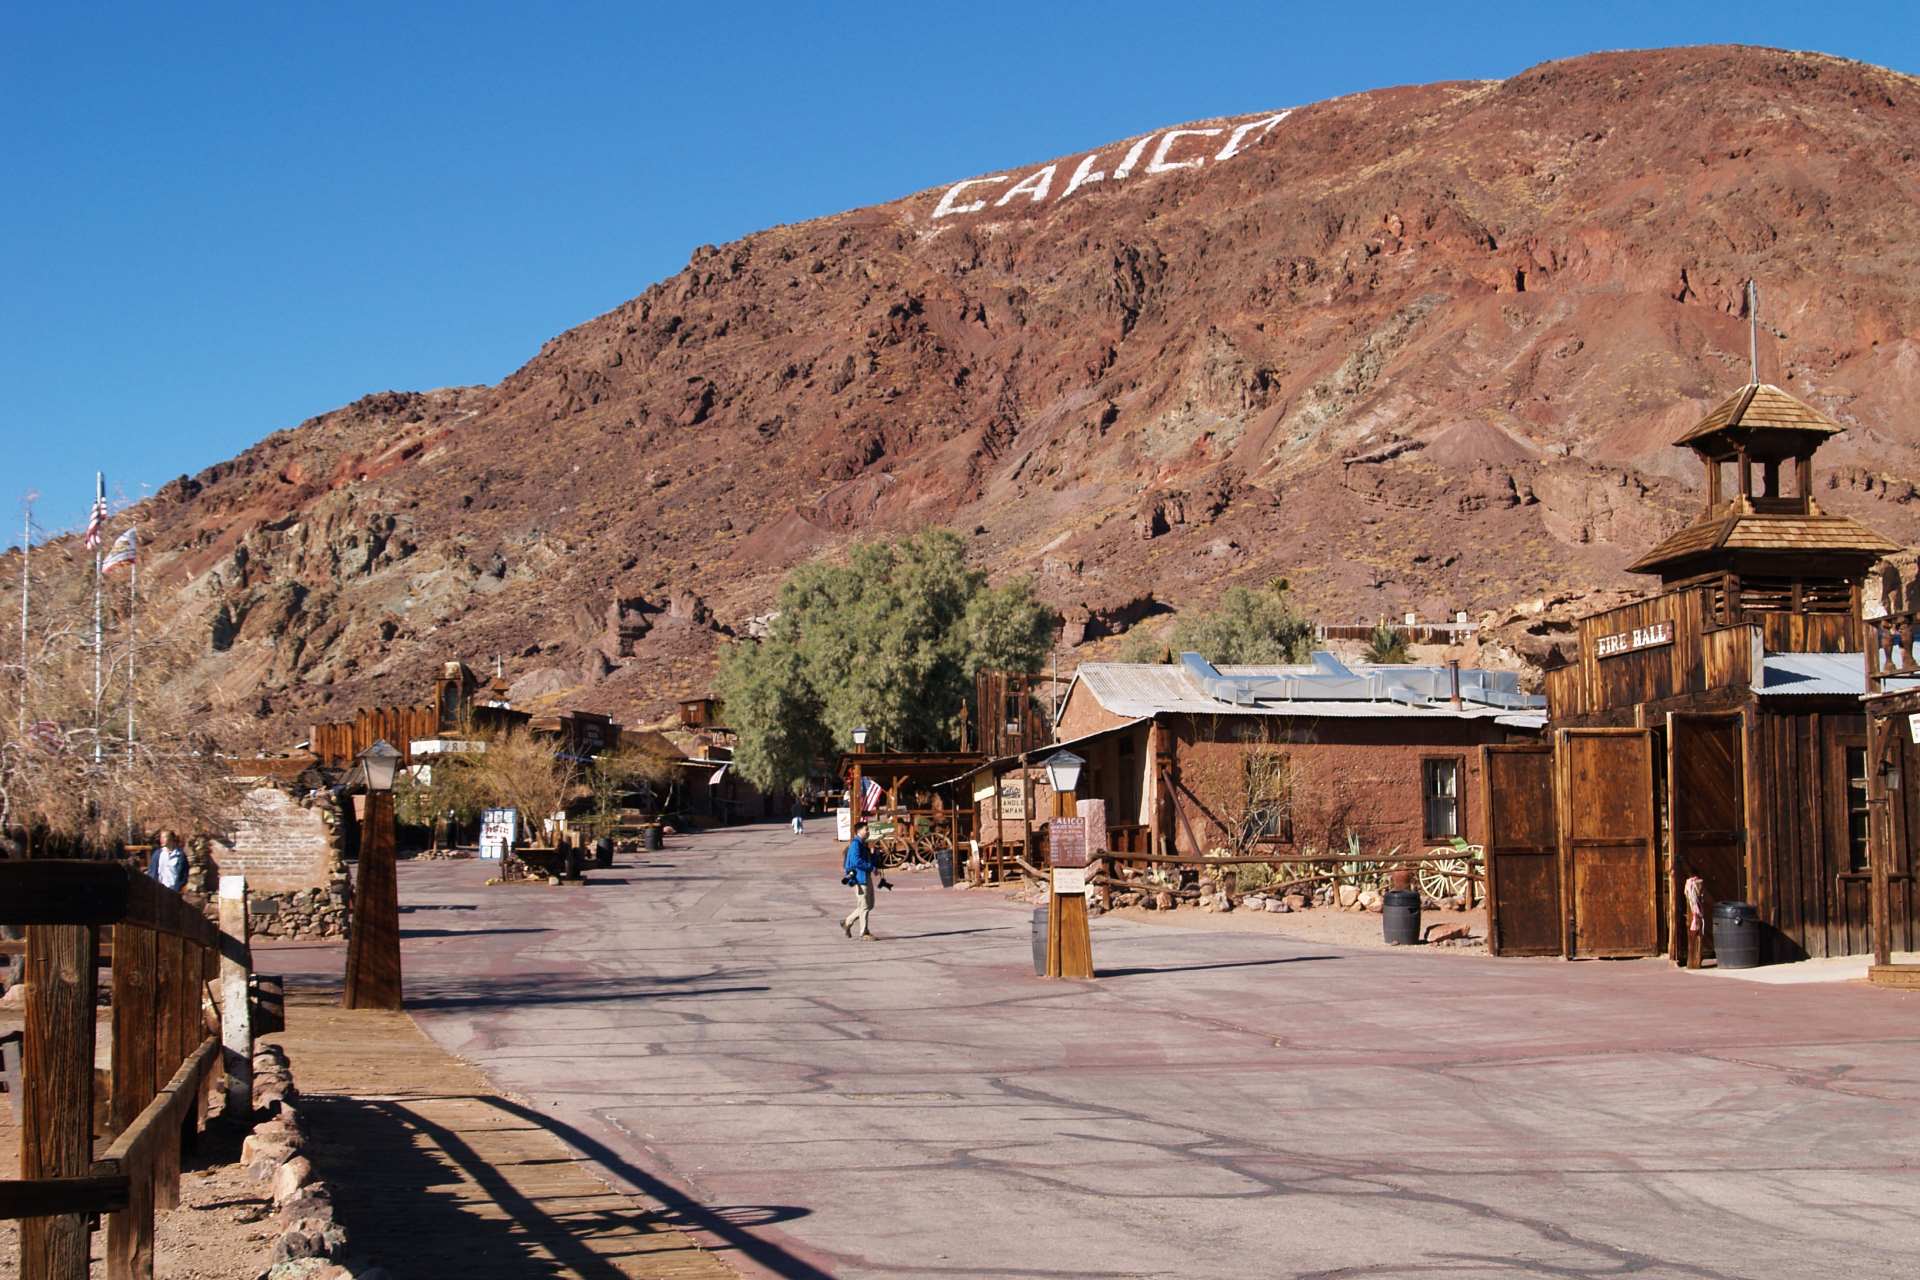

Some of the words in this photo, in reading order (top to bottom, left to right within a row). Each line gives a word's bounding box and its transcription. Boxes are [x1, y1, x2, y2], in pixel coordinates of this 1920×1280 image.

[932, 111, 1291, 218] CALICO
[1597, 633, 1627, 655] FIRE
[1632, 624, 1666, 648] HALL
[1050, 817, 1084, 825] CALICO
